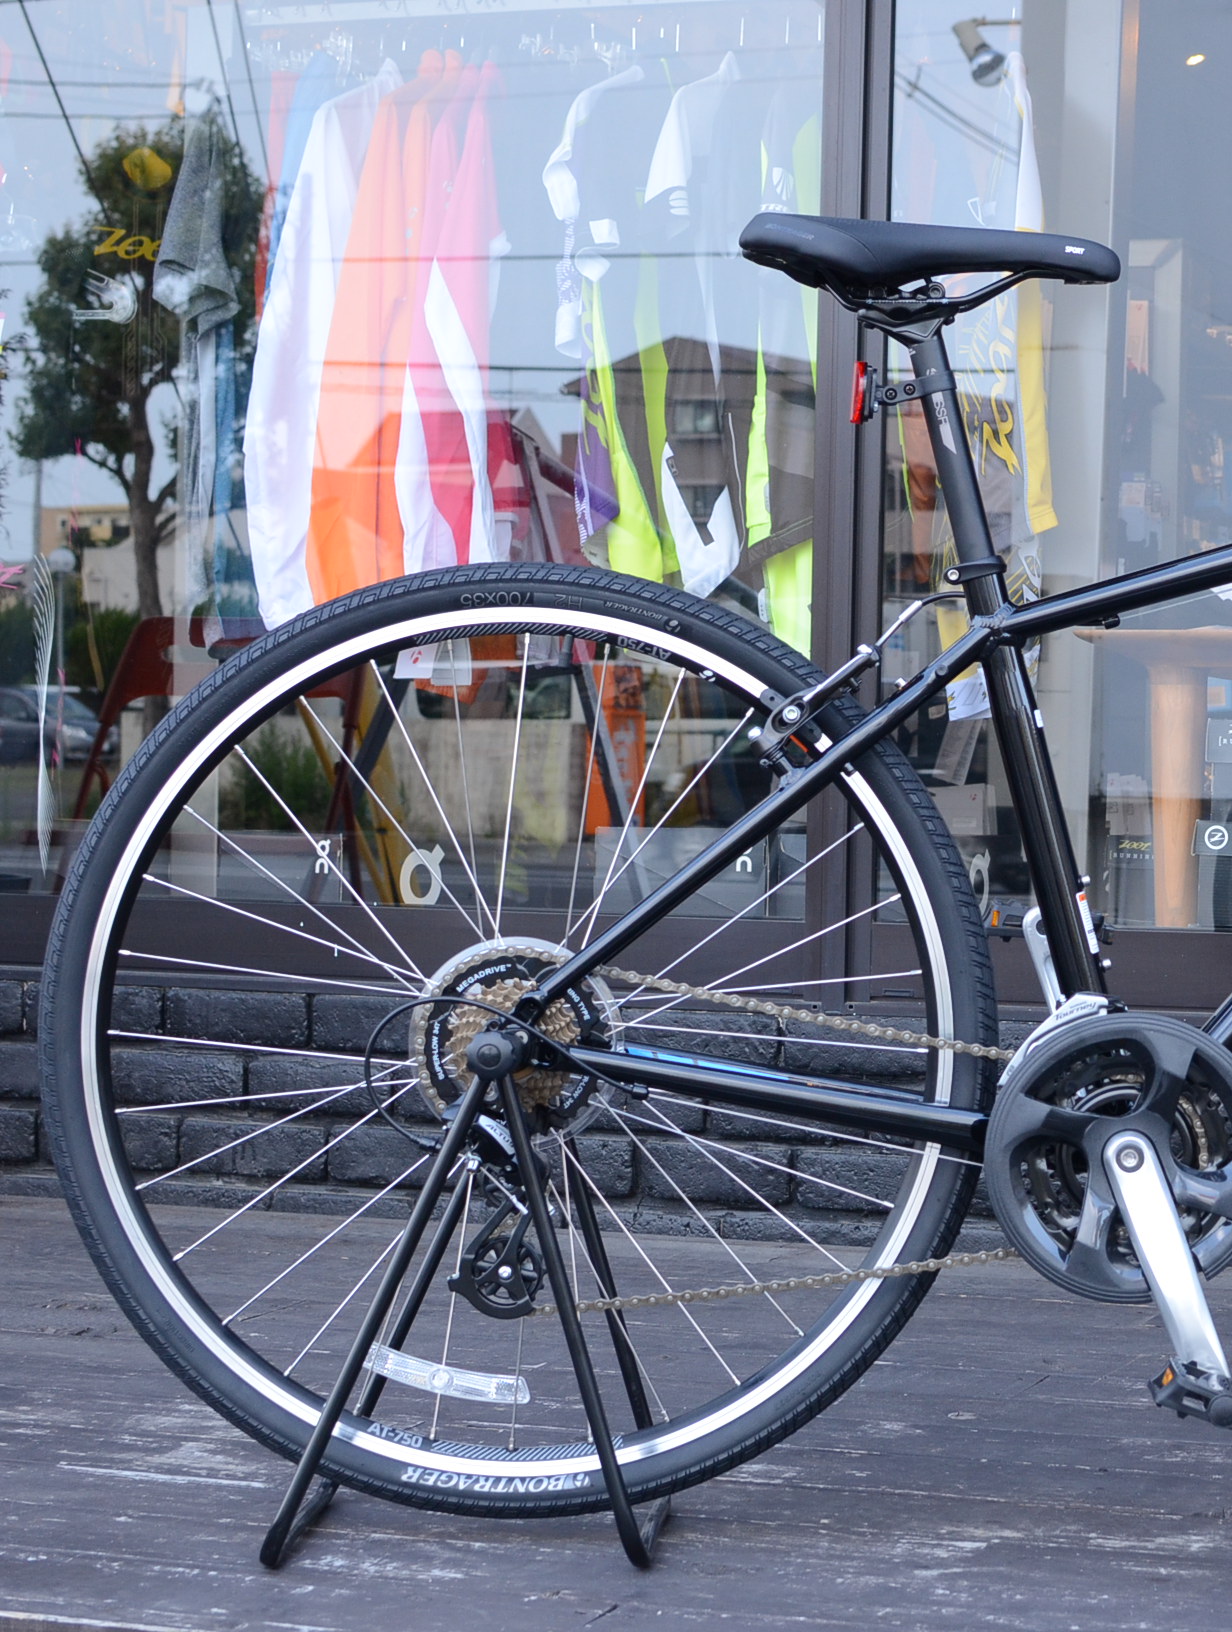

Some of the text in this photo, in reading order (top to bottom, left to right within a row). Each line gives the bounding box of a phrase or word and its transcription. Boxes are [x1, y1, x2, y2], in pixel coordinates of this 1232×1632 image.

[1064, 245, 1086, 255] SPORT
[460, 591, 532, 608] 700x35
[604, 600, 665, 622] BONTRAGER
[617, 635, 672, 661] AT-750
[577, 1001, 591, 1021] TYPE
[431, 1032, 445, 1081] SUPER-LOW
[367, 1422, 423, 1448] AT-750
[401, 1466, 565, 1493] BONTRAGER
